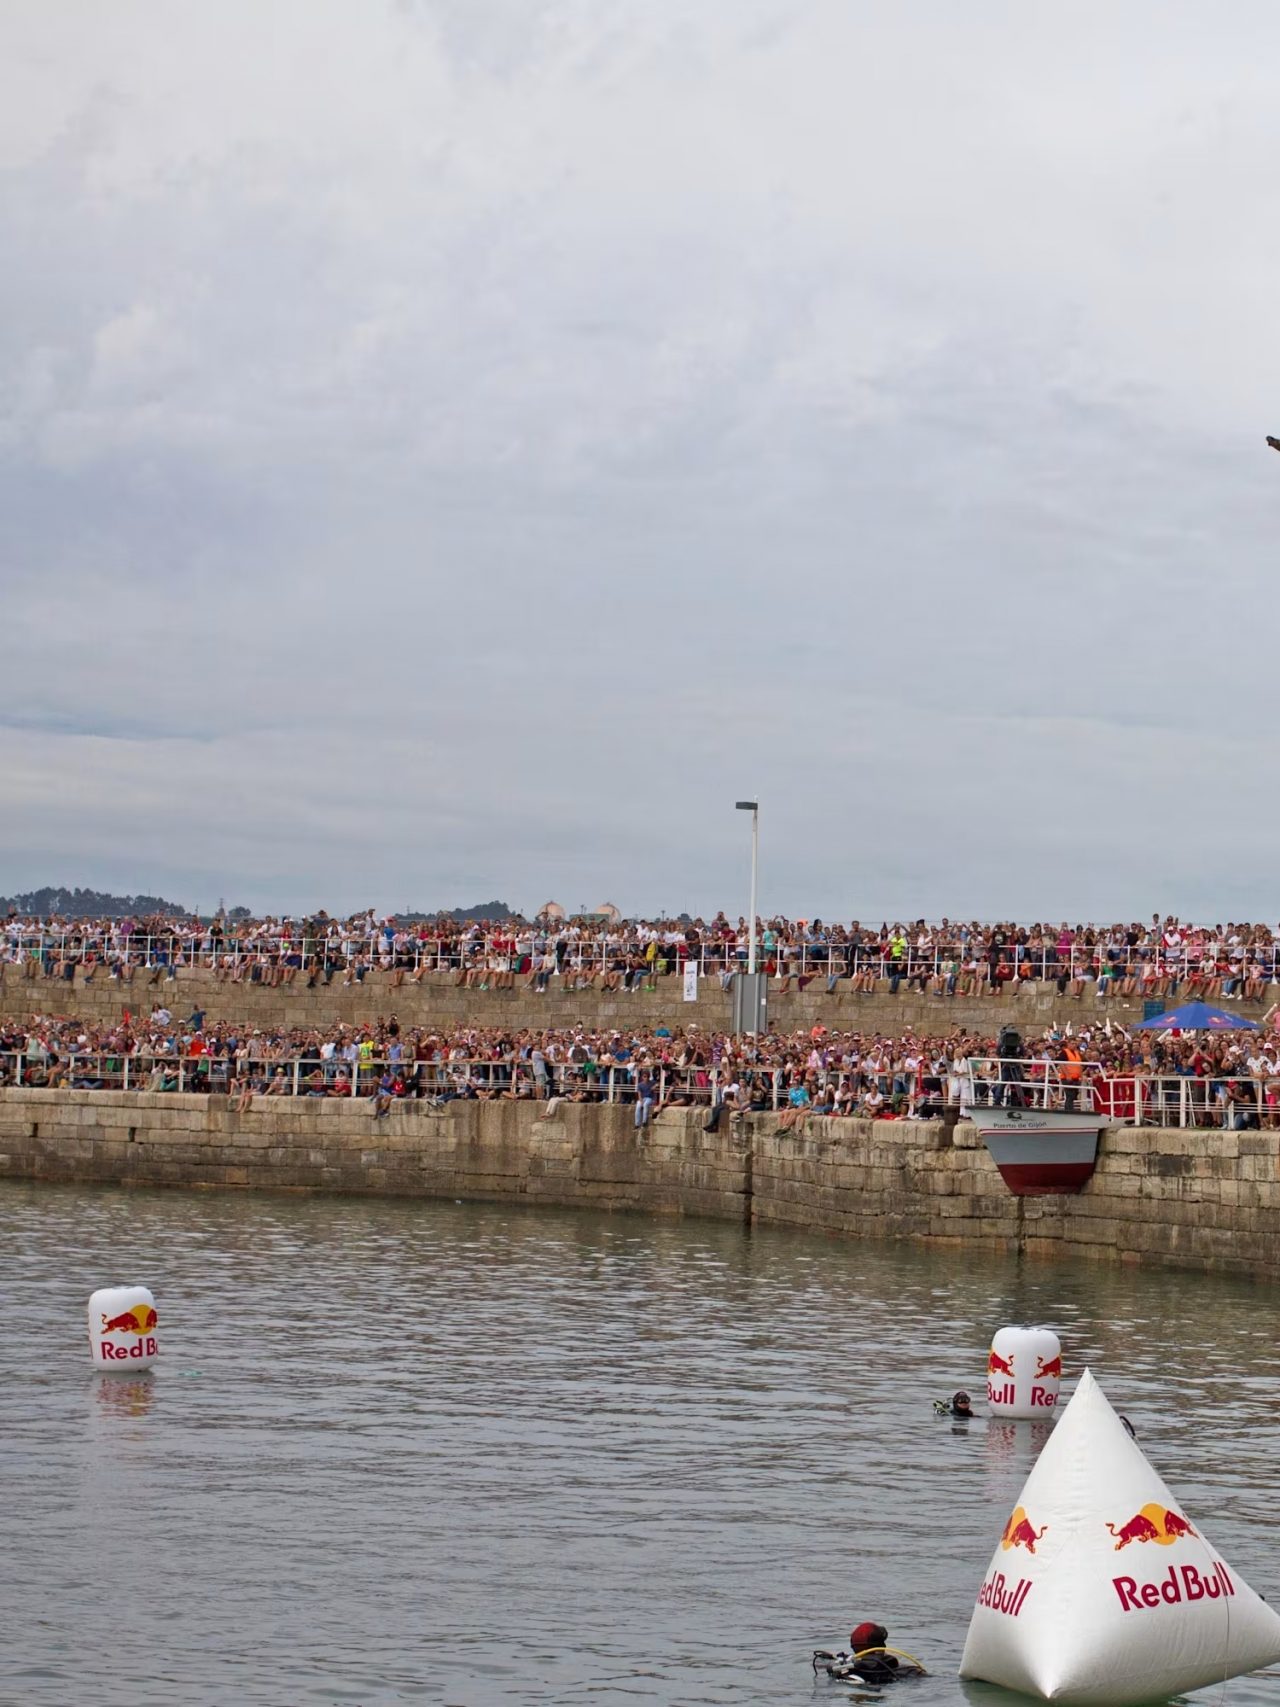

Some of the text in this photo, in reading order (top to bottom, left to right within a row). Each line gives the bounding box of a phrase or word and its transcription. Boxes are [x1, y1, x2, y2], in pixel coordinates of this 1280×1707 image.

[101, 1338, 143, 1360] Red
[977, 1570, 1033, 1617] ed Bull
[1112, 1561, 1235, 1612] Red Bull
